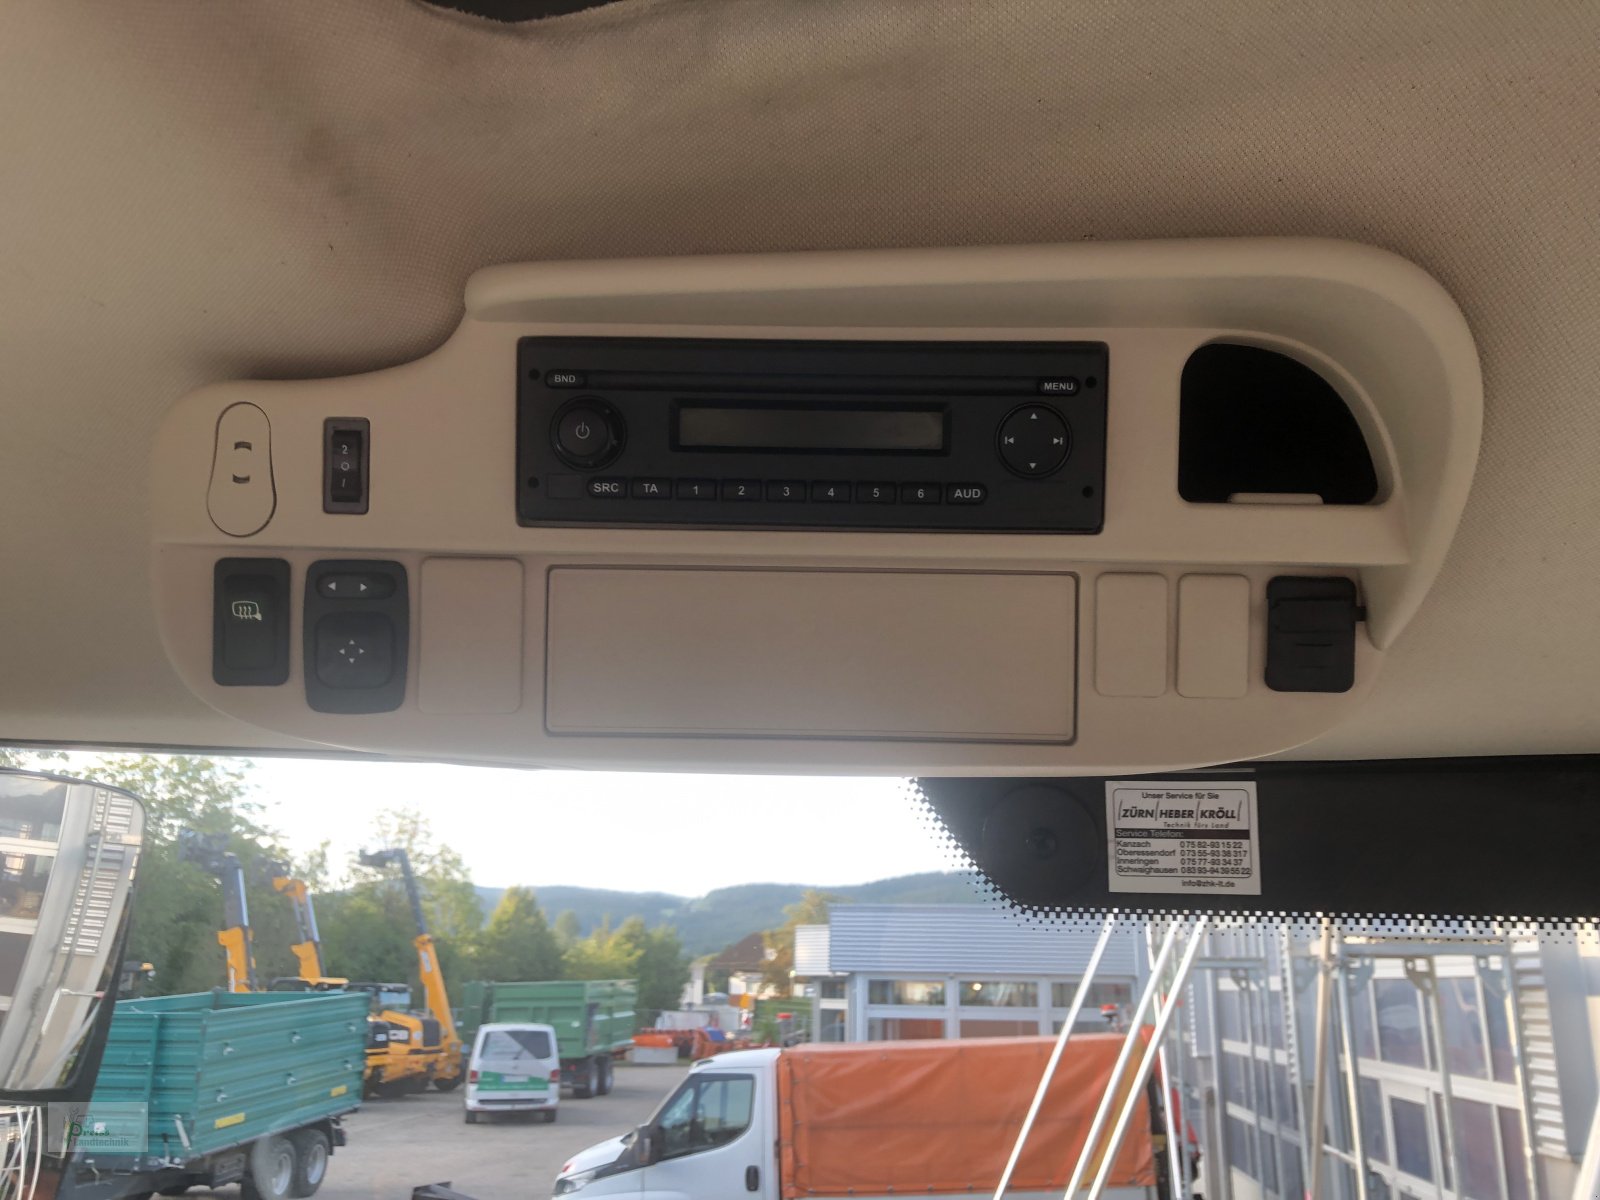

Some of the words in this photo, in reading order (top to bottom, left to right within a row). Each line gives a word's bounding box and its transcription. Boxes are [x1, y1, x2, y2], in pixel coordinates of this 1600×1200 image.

[554, 374, 576, 384] BND
[1044, 381, 1074, 392] MENU
[341, 444, 349, 455] 2
[593, 482, 619, 494] SRC
[643, 483, 659, 494] TA
[692, 485, 700, 496] 1
[737, 486, 746, 497] 2
[783, 487, 791, 498] 3
[826, 487, 836, 498] 4
[872, 487, 880, 499] 5
[916, 488, 925, 499] 6
[954, 488, 982, 500] AUD
[1194, 792, 1205, 800] für
[1207, 792, 1220, 800] Sie
[1211, 821, 1230, 829] Land
[1116, 829, 1148, 838] Service
[1150, 830, 1184, 838] Telefon:
[1116, 840, 1152, 848] Kanzach
[1117, 848, 1176, 857] Oberessendorf
[1117, 857, 1160, 867] Inneringen
[1117, 865, 1179, 875] Schwaighausen
